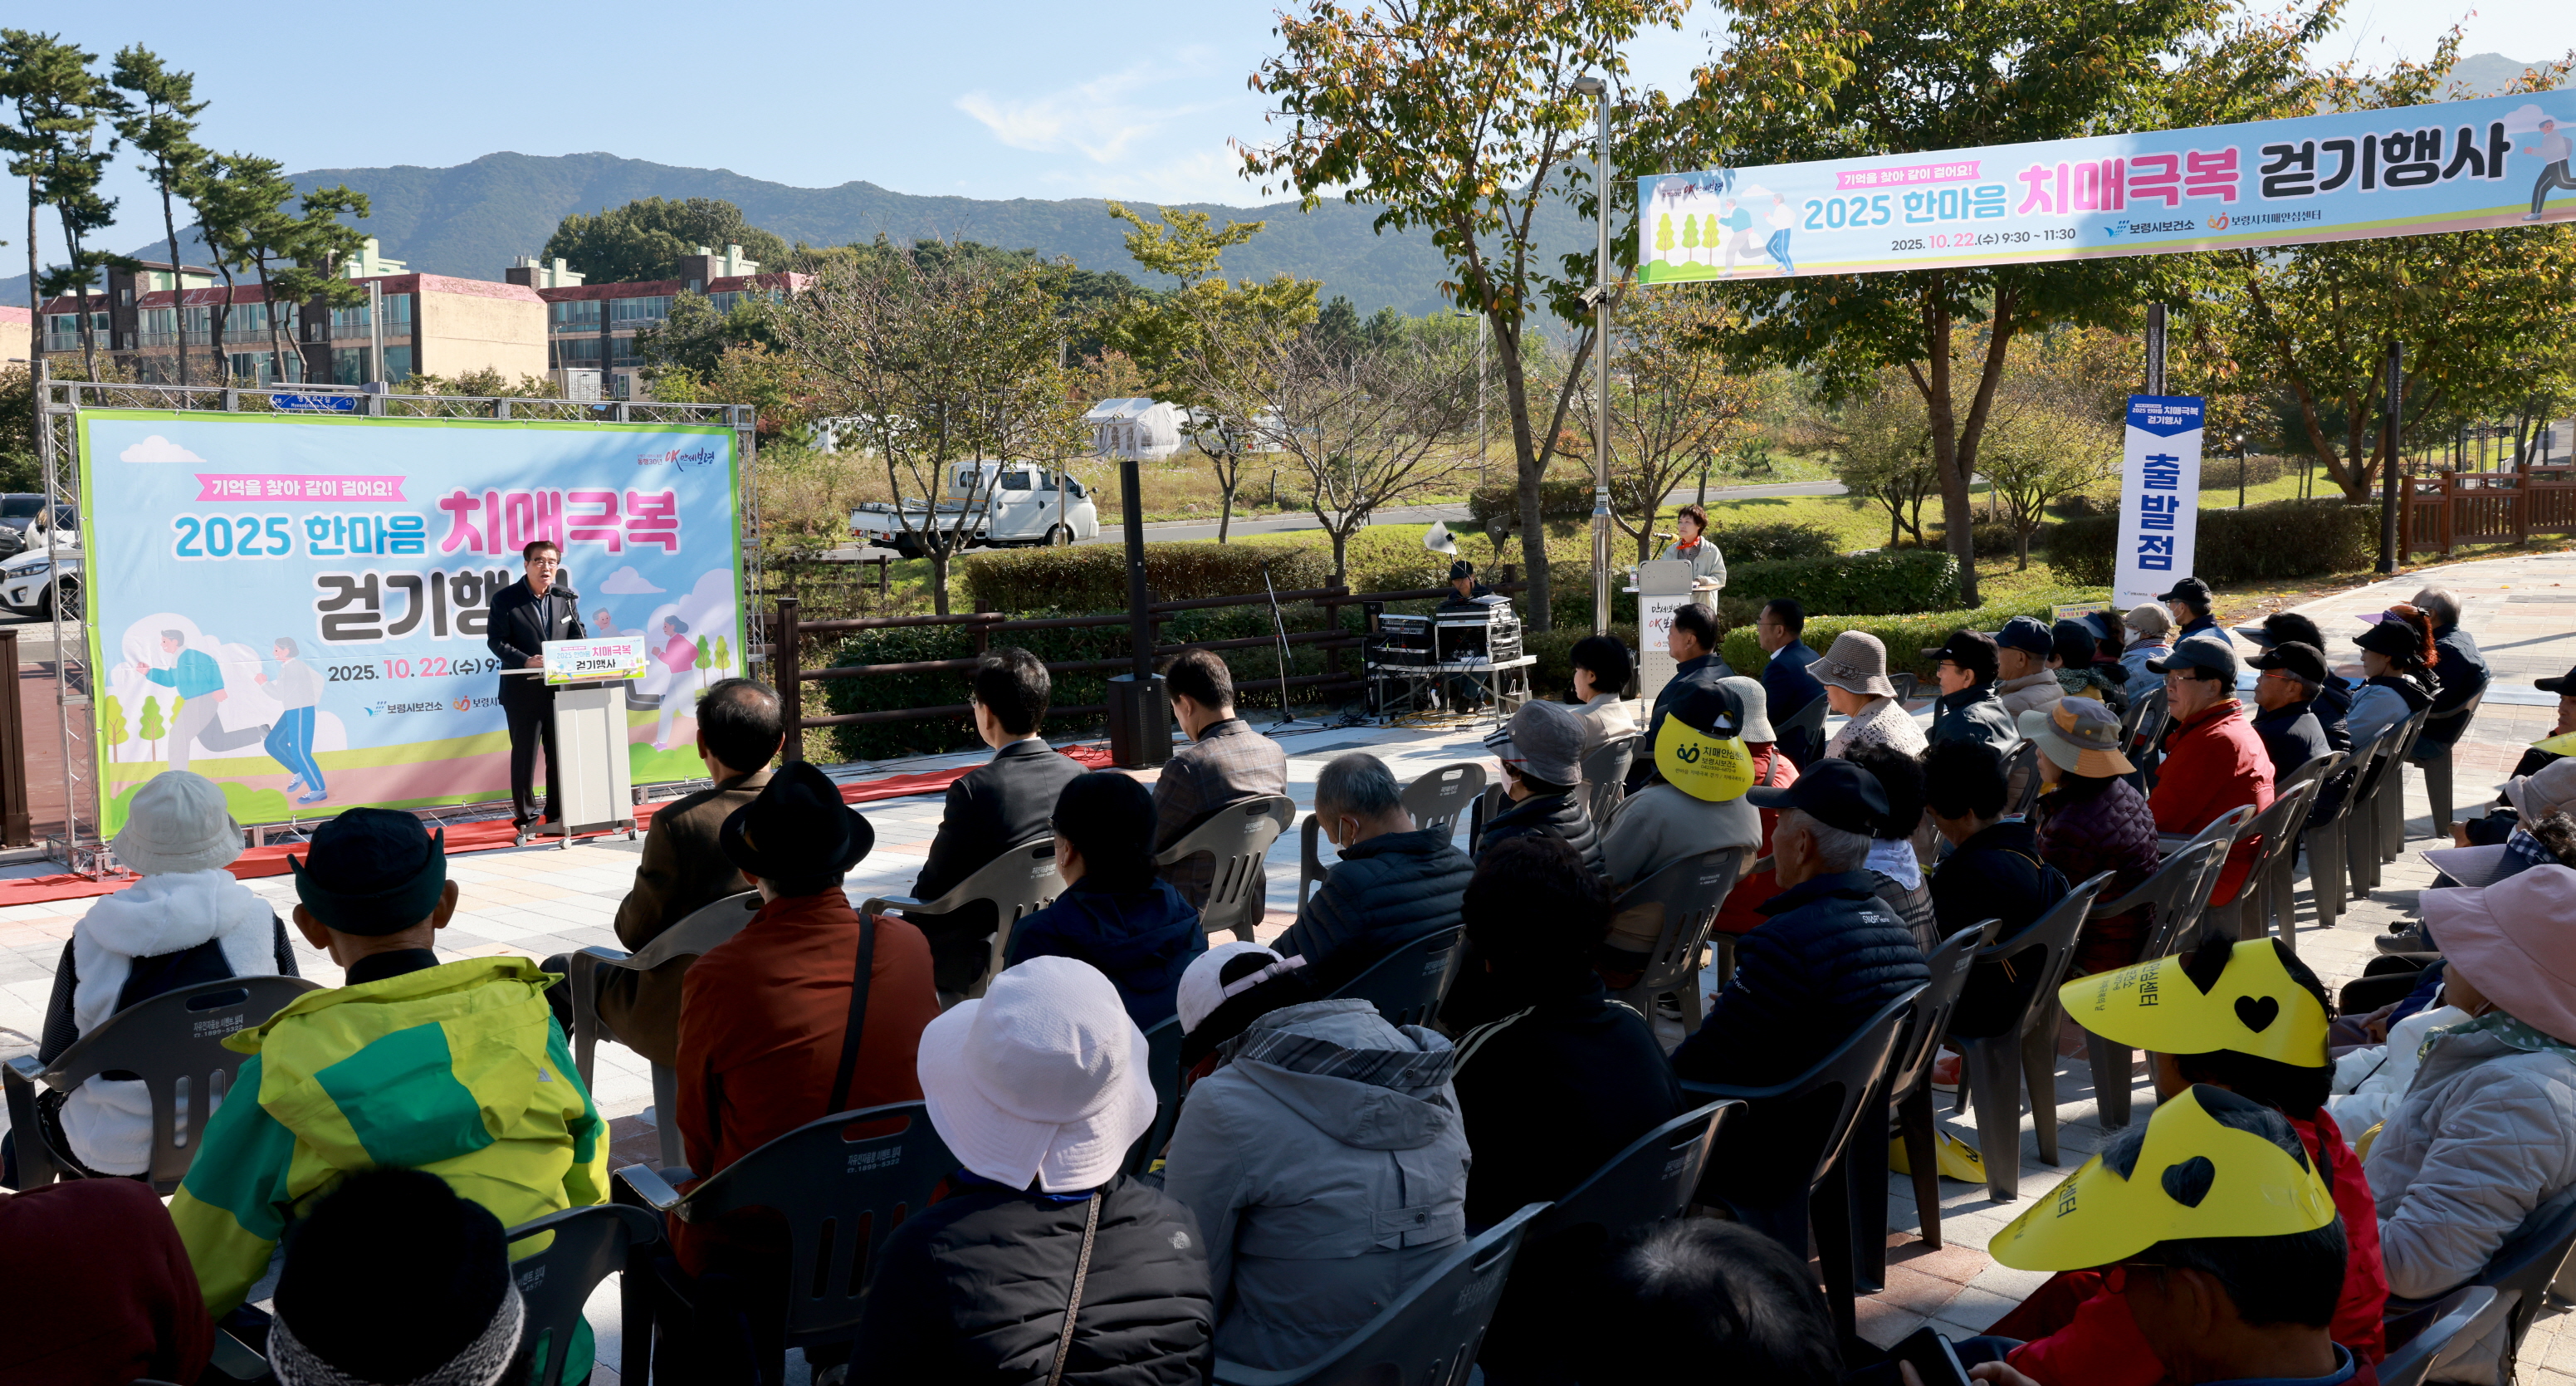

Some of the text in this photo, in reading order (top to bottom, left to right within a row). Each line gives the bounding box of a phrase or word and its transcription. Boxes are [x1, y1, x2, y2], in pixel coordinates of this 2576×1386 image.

[1804, 122, 2510, 231] 2025 한마음 치매극복 걷기행사
[1844, 164, 1972, 186] 기억을 찾아 같이 걸어요!
[2231, 209, 2321, 226] 보령시치매안심센터
[2129, 219, 2195, 234] 보령시보건소
[1892, 239, 1926, 251] 2025.
[1928, 234, 1950, 249] 10.
[2002, 231, 2031, 244] 9:30
[2044, 228, 2076, 241] 11:30
[2163, 405, 2199, 416] 치매극복
[2148, 415, 2183, 425] 걷기행사
[637, 458, 662, 466] 동행30년
[212, 479, 393, 497] 기억을 찾아 같이 걸어요!
[2137, 453, 2180, 571] 출발점
[175, 490, 678, 557] 2025 한마음 치매극복
[317, 570, 568, 641] 걷기행
[574, 650, 591, 659] 한마음
[592, 644, 632, 657] 치매극복
[328, 664, 379, 682] 2025.
[384, 659, 415, 679] 10.
[576, 659, 617, 671] 걷기행사
[387, 701, 443, 714] 보령시보건소
[472, 698, 500, 708] 보령시
[1701, 757, 1737, 768] 보령시보건소
[1702, 747, 1744, 762] 치매안심센터
[2139, 961, 2161, 1006] 안심센터
